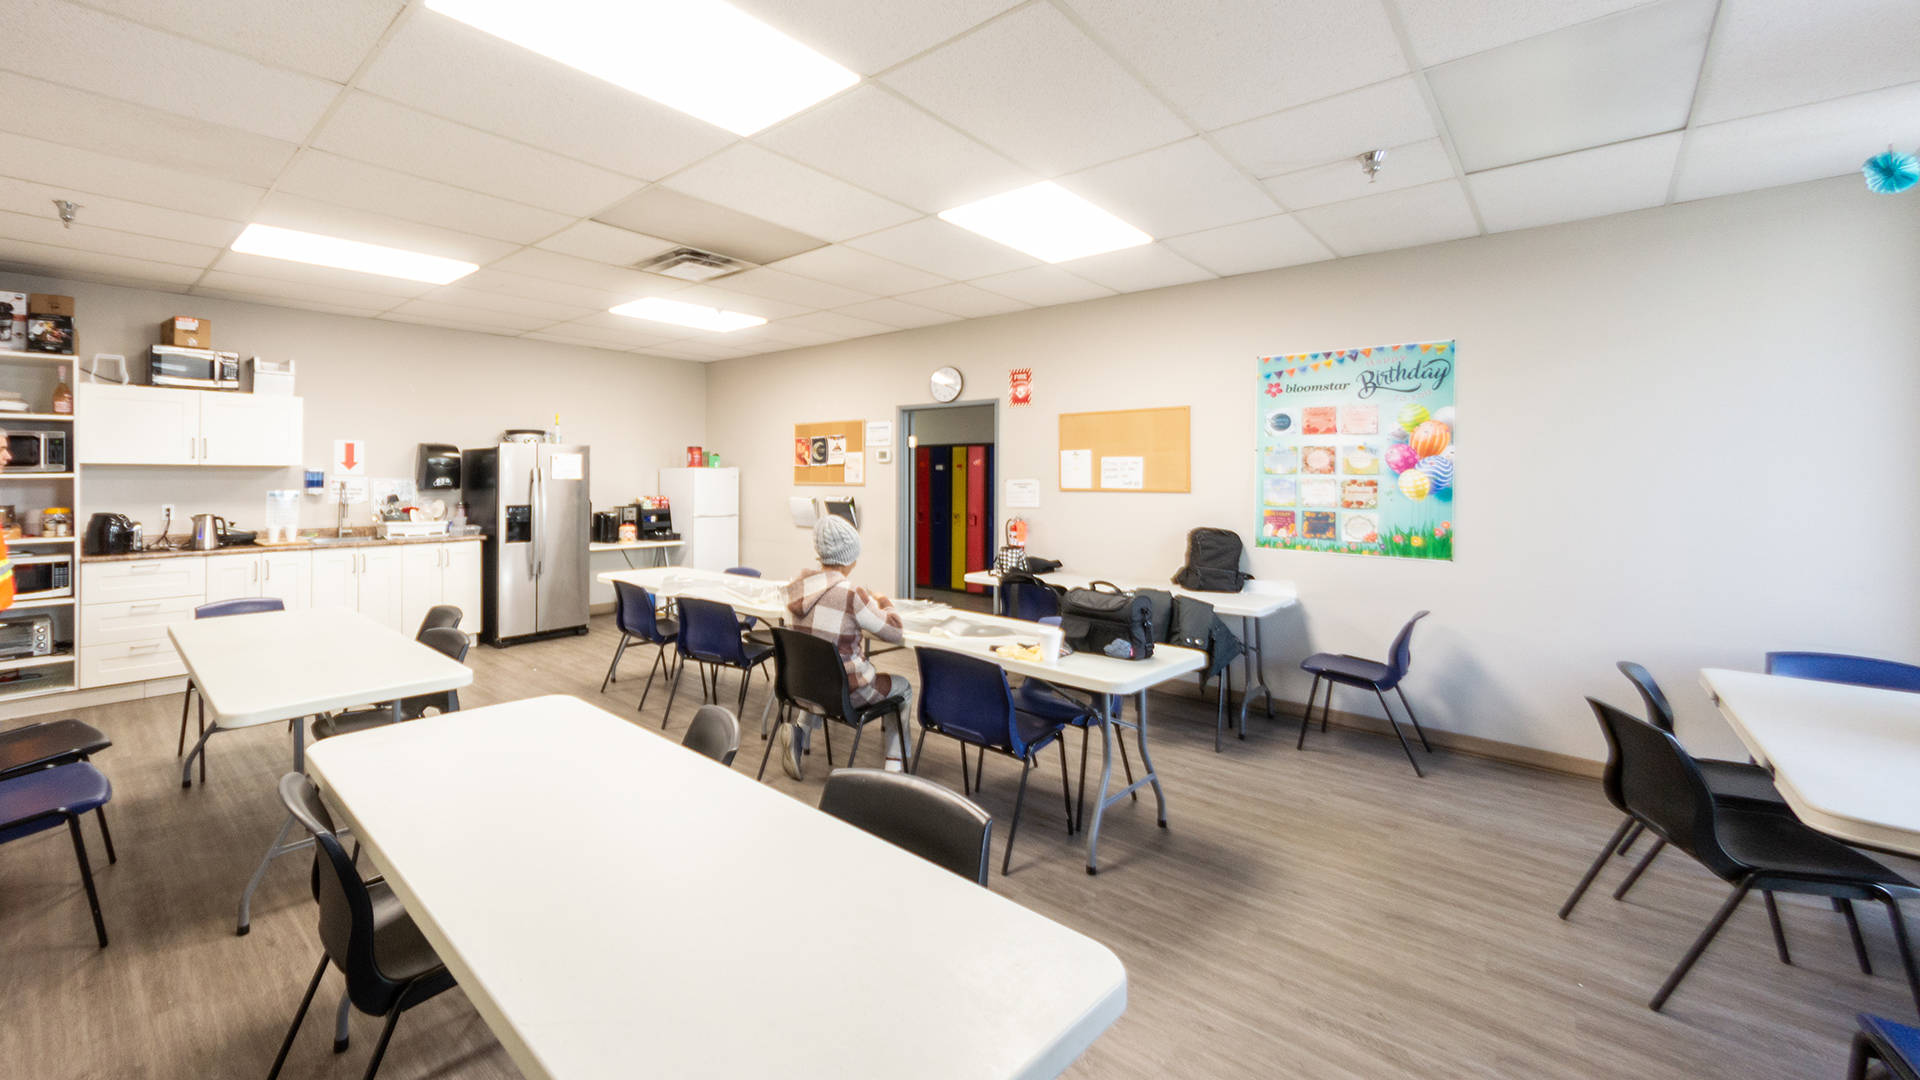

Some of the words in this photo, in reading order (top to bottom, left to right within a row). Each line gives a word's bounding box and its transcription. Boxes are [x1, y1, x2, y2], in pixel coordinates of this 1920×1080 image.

[1366, 355, 1407, 367] Happy
[1356, 358, 1451, 399] Birthday
[1285, 382, 1351, 394] bloomstar
